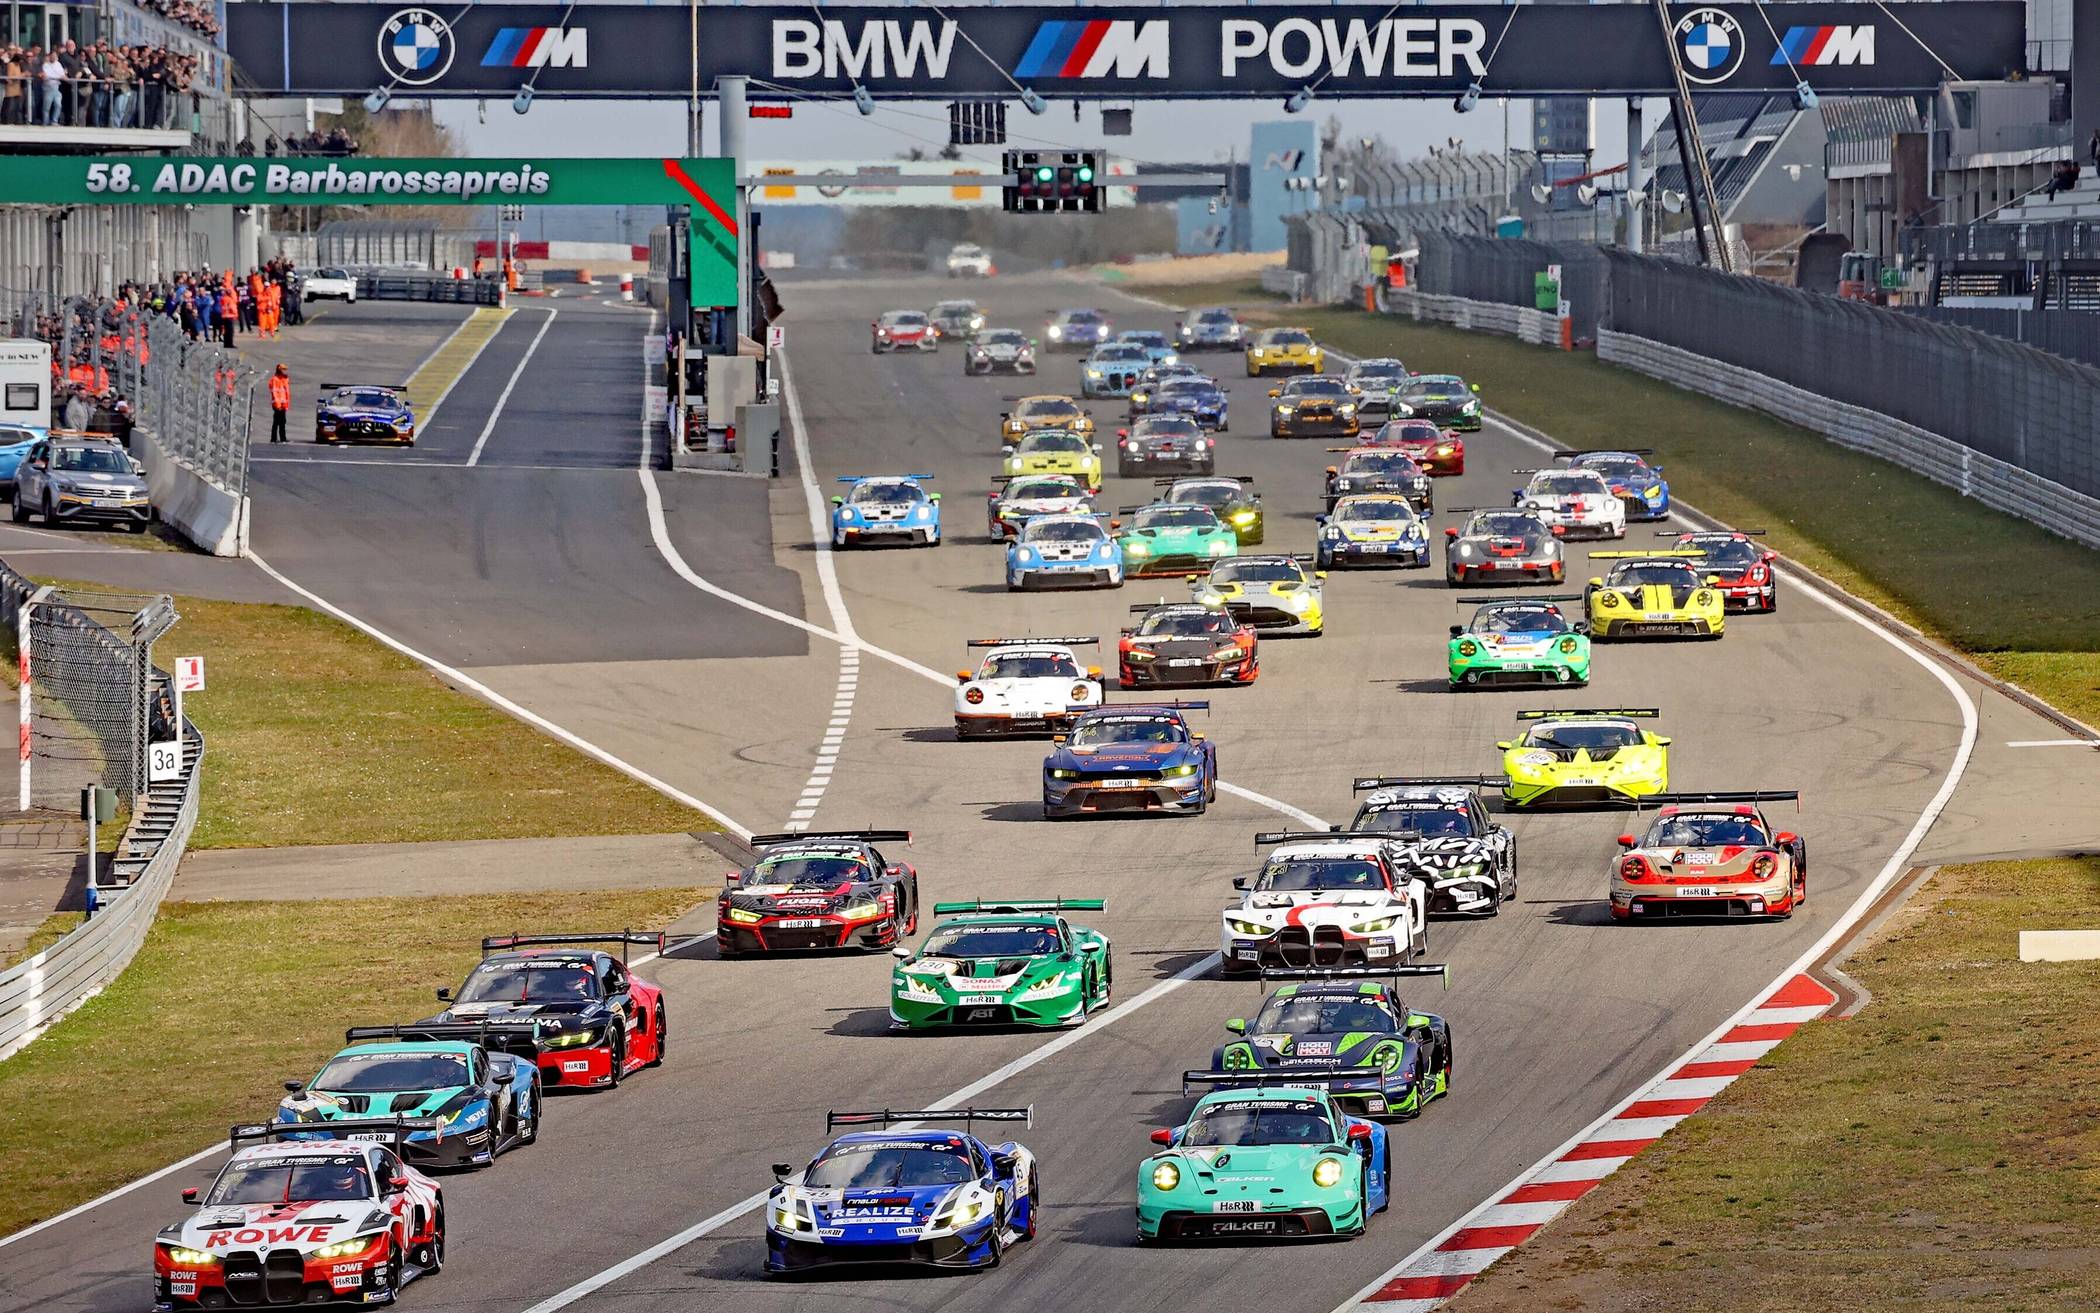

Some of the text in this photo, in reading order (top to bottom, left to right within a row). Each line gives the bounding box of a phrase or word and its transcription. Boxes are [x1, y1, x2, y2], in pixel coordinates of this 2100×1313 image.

[389, 13, 444, 34] BMW
[1681, 12, 1735, 34] BMW
[772, 18, 1488, 79] BMW M POWER
[86, 163, 550, 201] 58. ADAC Barbarossapreis
[154, 749, 175, 771] 3a
[966, 996, 984, 1004] H&R
[967, 1008, 996, 1022] ABT
[354, 1134, 374, 1142] H&R
[831, 1206, 915, 1217] REALIZE
[1220, 1202, 1241, 1211] H&R
[1212, 1221, 1276, 1231] FALKEN
[205, 1226, 334, 1248] ROWE
[333, 1262, 363, 1274] ROWE
[169, 1270, 197, 1280] ROWE
[335, 1277, 350, 1286] H&R
[172, 1283, 185, 1293] H&R
